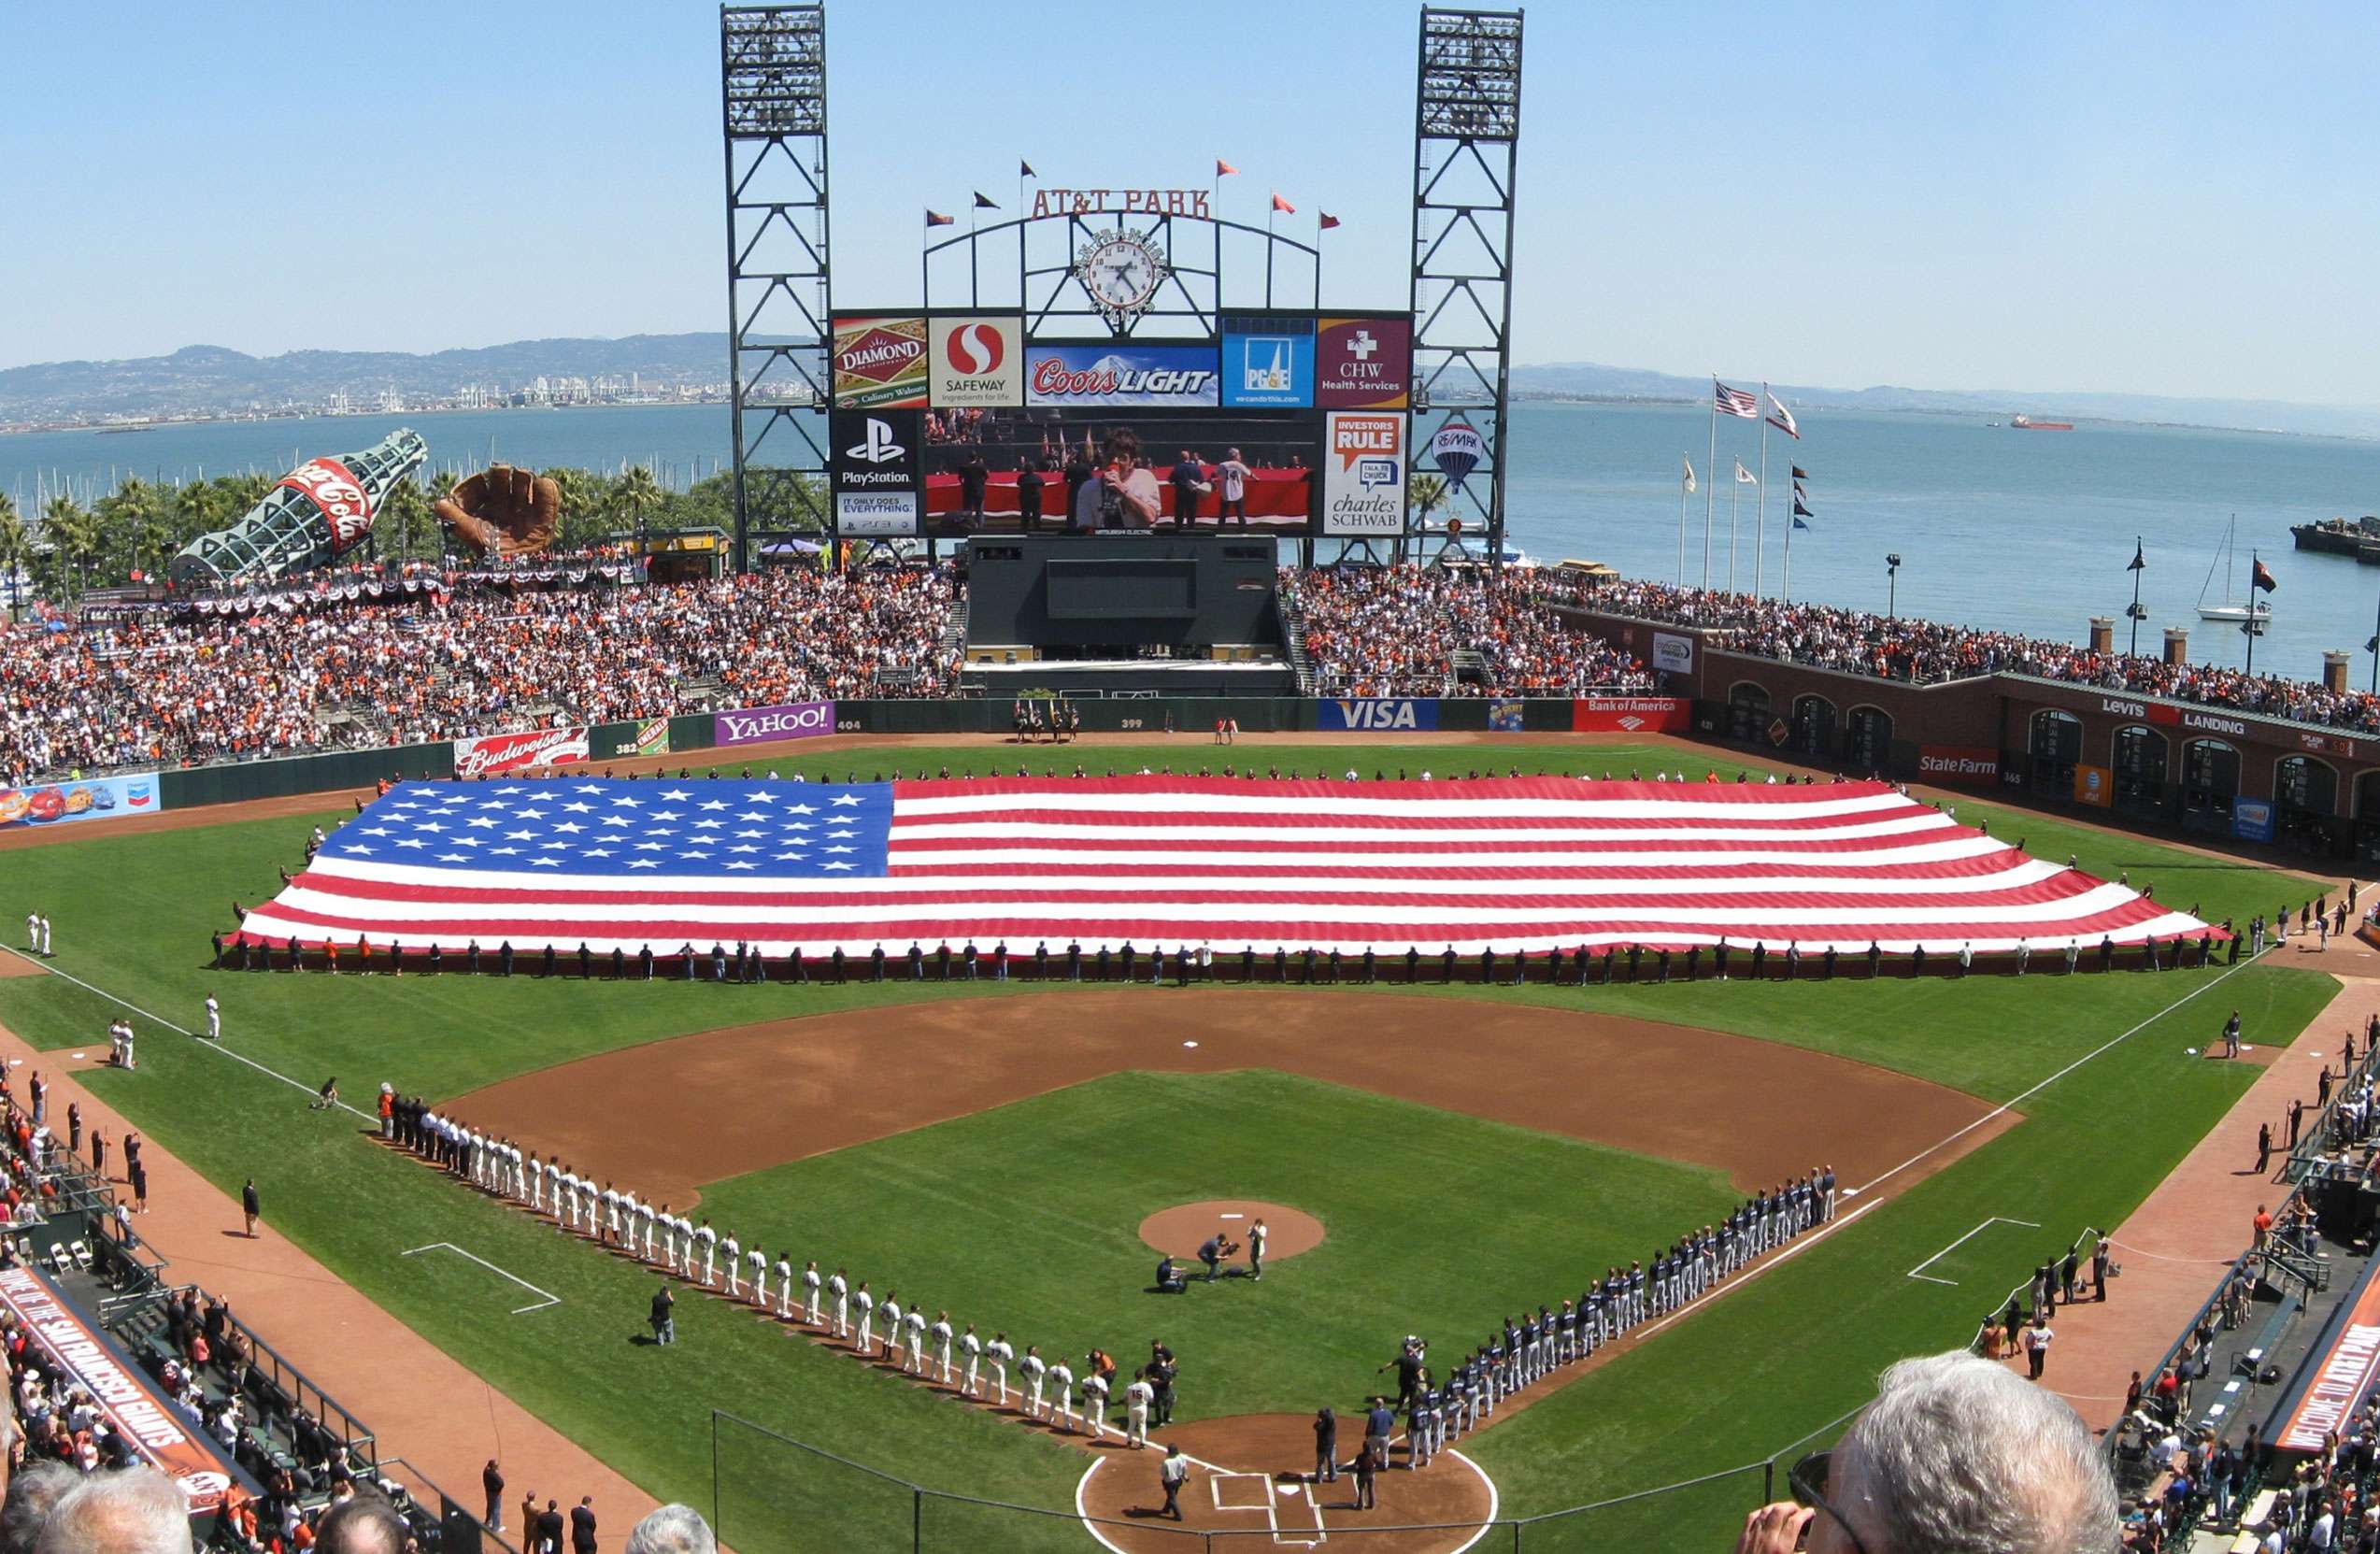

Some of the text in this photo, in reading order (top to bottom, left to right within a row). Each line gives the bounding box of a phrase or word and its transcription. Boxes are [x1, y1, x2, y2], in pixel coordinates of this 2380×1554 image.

[1032, 190, 1209, 221] AT&T PARK
[842, 341, 920, 371] DIAMOND
[1033, 358, 1212, 396] Coors LIGHT
[1247, 368, 1290, 389] PG&E
[1340, 363, 1383, 378] CHW
[946, 379, 1005, 392] SAFEWAY
[1322, 379, 1400, 391] Health Services
[861, 385, 927, 404] Culinary Walnuts
[985, 393, 995, 402] for
[1338, 421, 1393, 431] INVESTORS
[1337, 431, 1393, 449] RULE
[1437, 433, 1477, 449] RE/MAX
[842, 472, 910, 486] PlayStation
[1333, 493, 1396, 513] charles
[1333, 514, 1397, 526] SCHWAB
[1336, 701, 1416, 729] VISA
[1589, 701, 1675, 711] Bank of America
[637, 718, 669, 747] EMERALD
[720, 706, 827, 741] YAHOO!
[837, 720, 861, 731] 404
[1121, 719, 1143, 728] 399
[2185, 713, 2245, 734] LANDING
[459, 729, 573, 777] Budweiser
[616, 743, 637, 755] 382
[1919, 755, 1997, 775] State Farm
[2003, 772, 2021, 784] 365
[13, 1291, 50, 1304] OF
[24, 1303, 65, 1322] THE
[39, 1320, 86, 1344] SAN
[58, 1341, 142, 1403] FRANCISCO
[2323, 1352, 2370, 1383] AT&T
[1132, 1390, 1144, 1399] 15
[2314, 1383, 2354, 1396] TO
[115, 1401, 185, 1447] GIANTS
